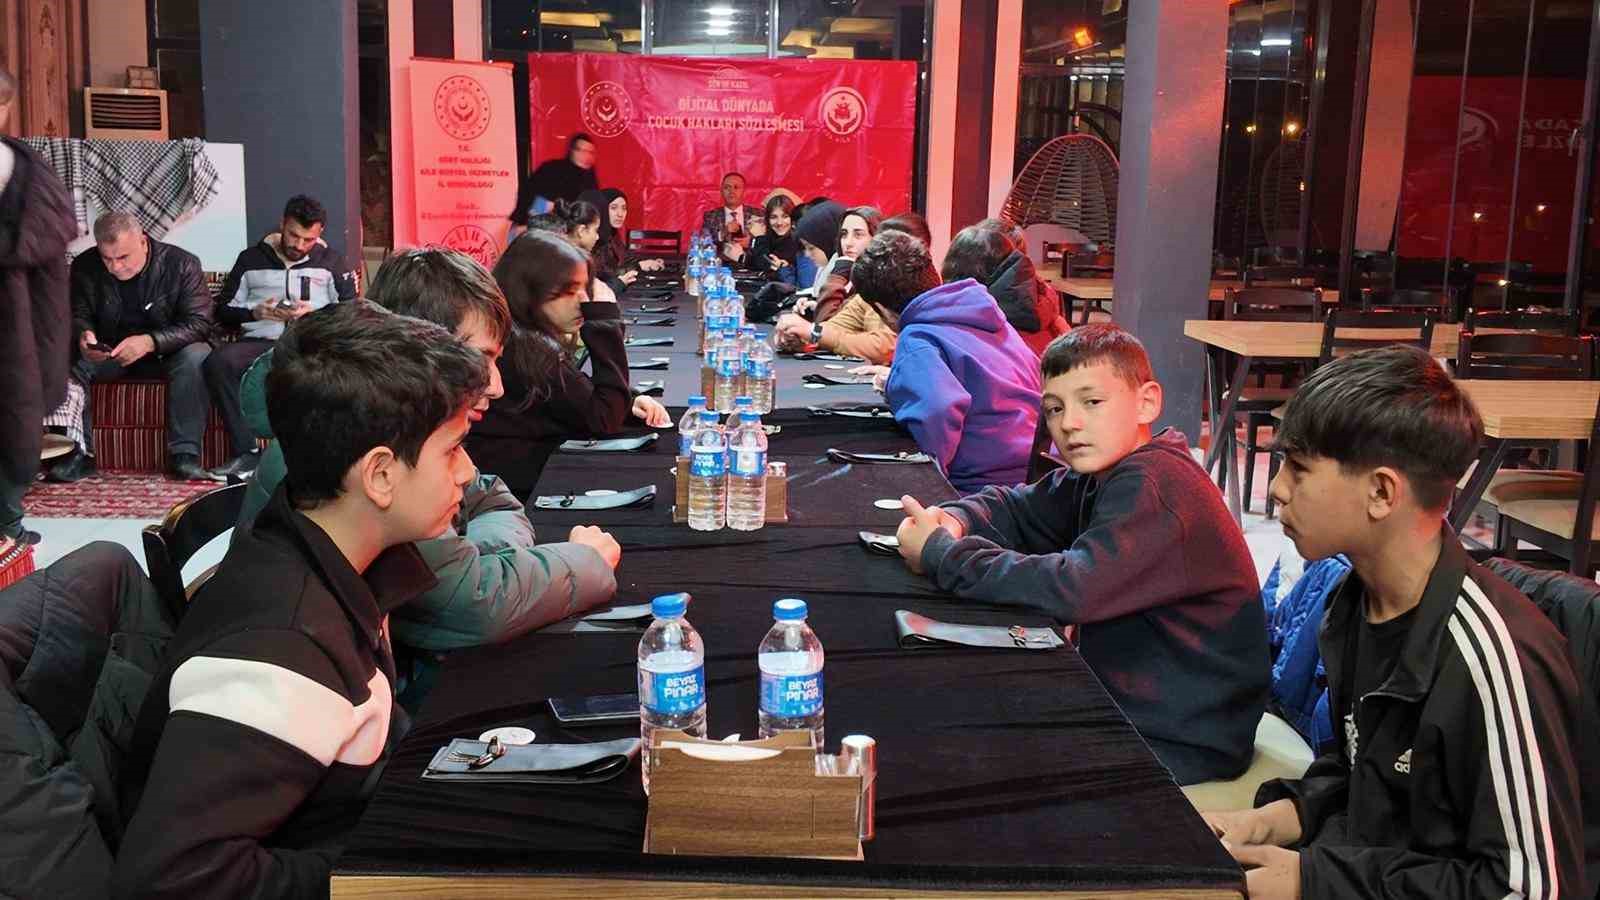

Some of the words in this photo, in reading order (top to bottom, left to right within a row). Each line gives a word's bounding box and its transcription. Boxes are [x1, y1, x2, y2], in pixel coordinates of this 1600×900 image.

[677, 95, 720, 113] DİJİTAL
[722, 96, 775, 113] DÜNYADA
[647, 114, 686, 130] ÇOCUK
[687, 115, 737, 130] HAKLARI
[738, 114, 805, 133] SÖZLEŞMESİ
[666, 674, 697, 688] BEYAZ
[788, 679, 818, 691] BEYAZ
[664, 683, 699, 698] PINAR
